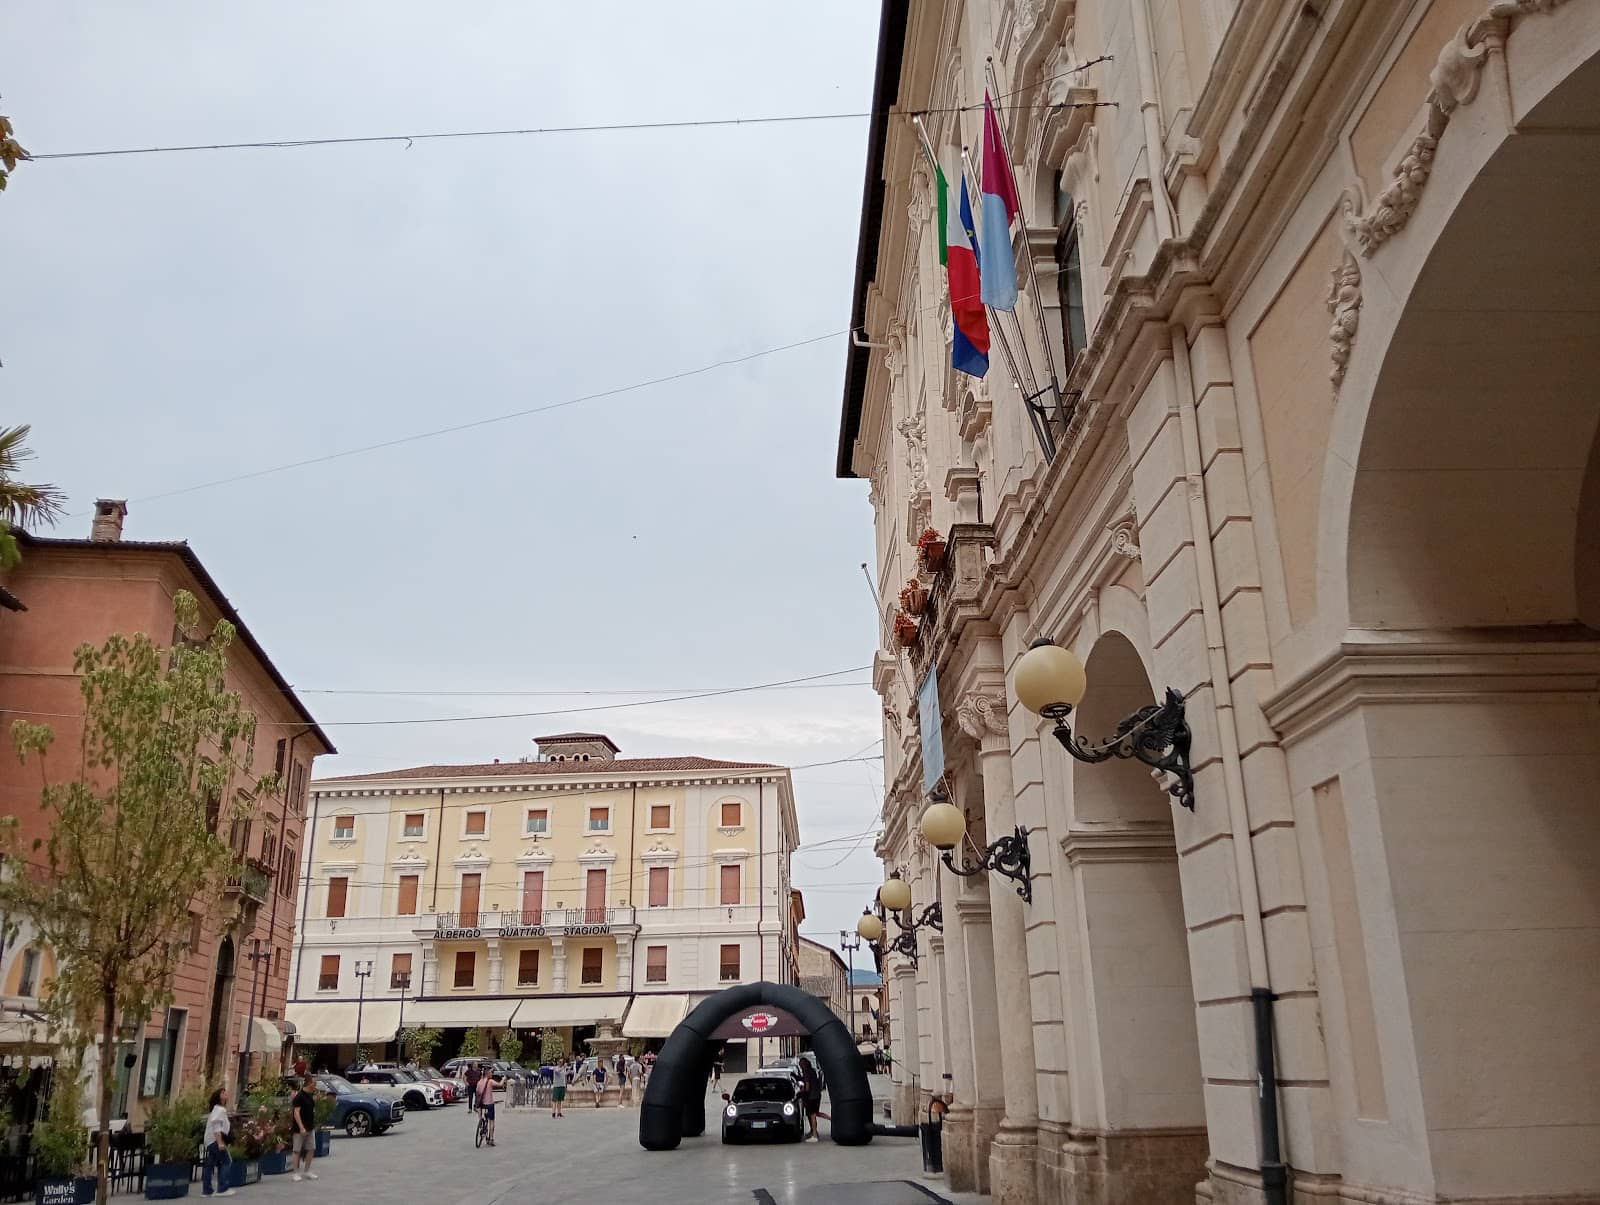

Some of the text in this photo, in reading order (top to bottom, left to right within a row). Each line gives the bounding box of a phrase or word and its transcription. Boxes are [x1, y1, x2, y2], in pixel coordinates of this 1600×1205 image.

[433, 925, 611, 939] ALBERGO QUATTRO STAGIONI
[42, 1195, 74, 1204] Garden
